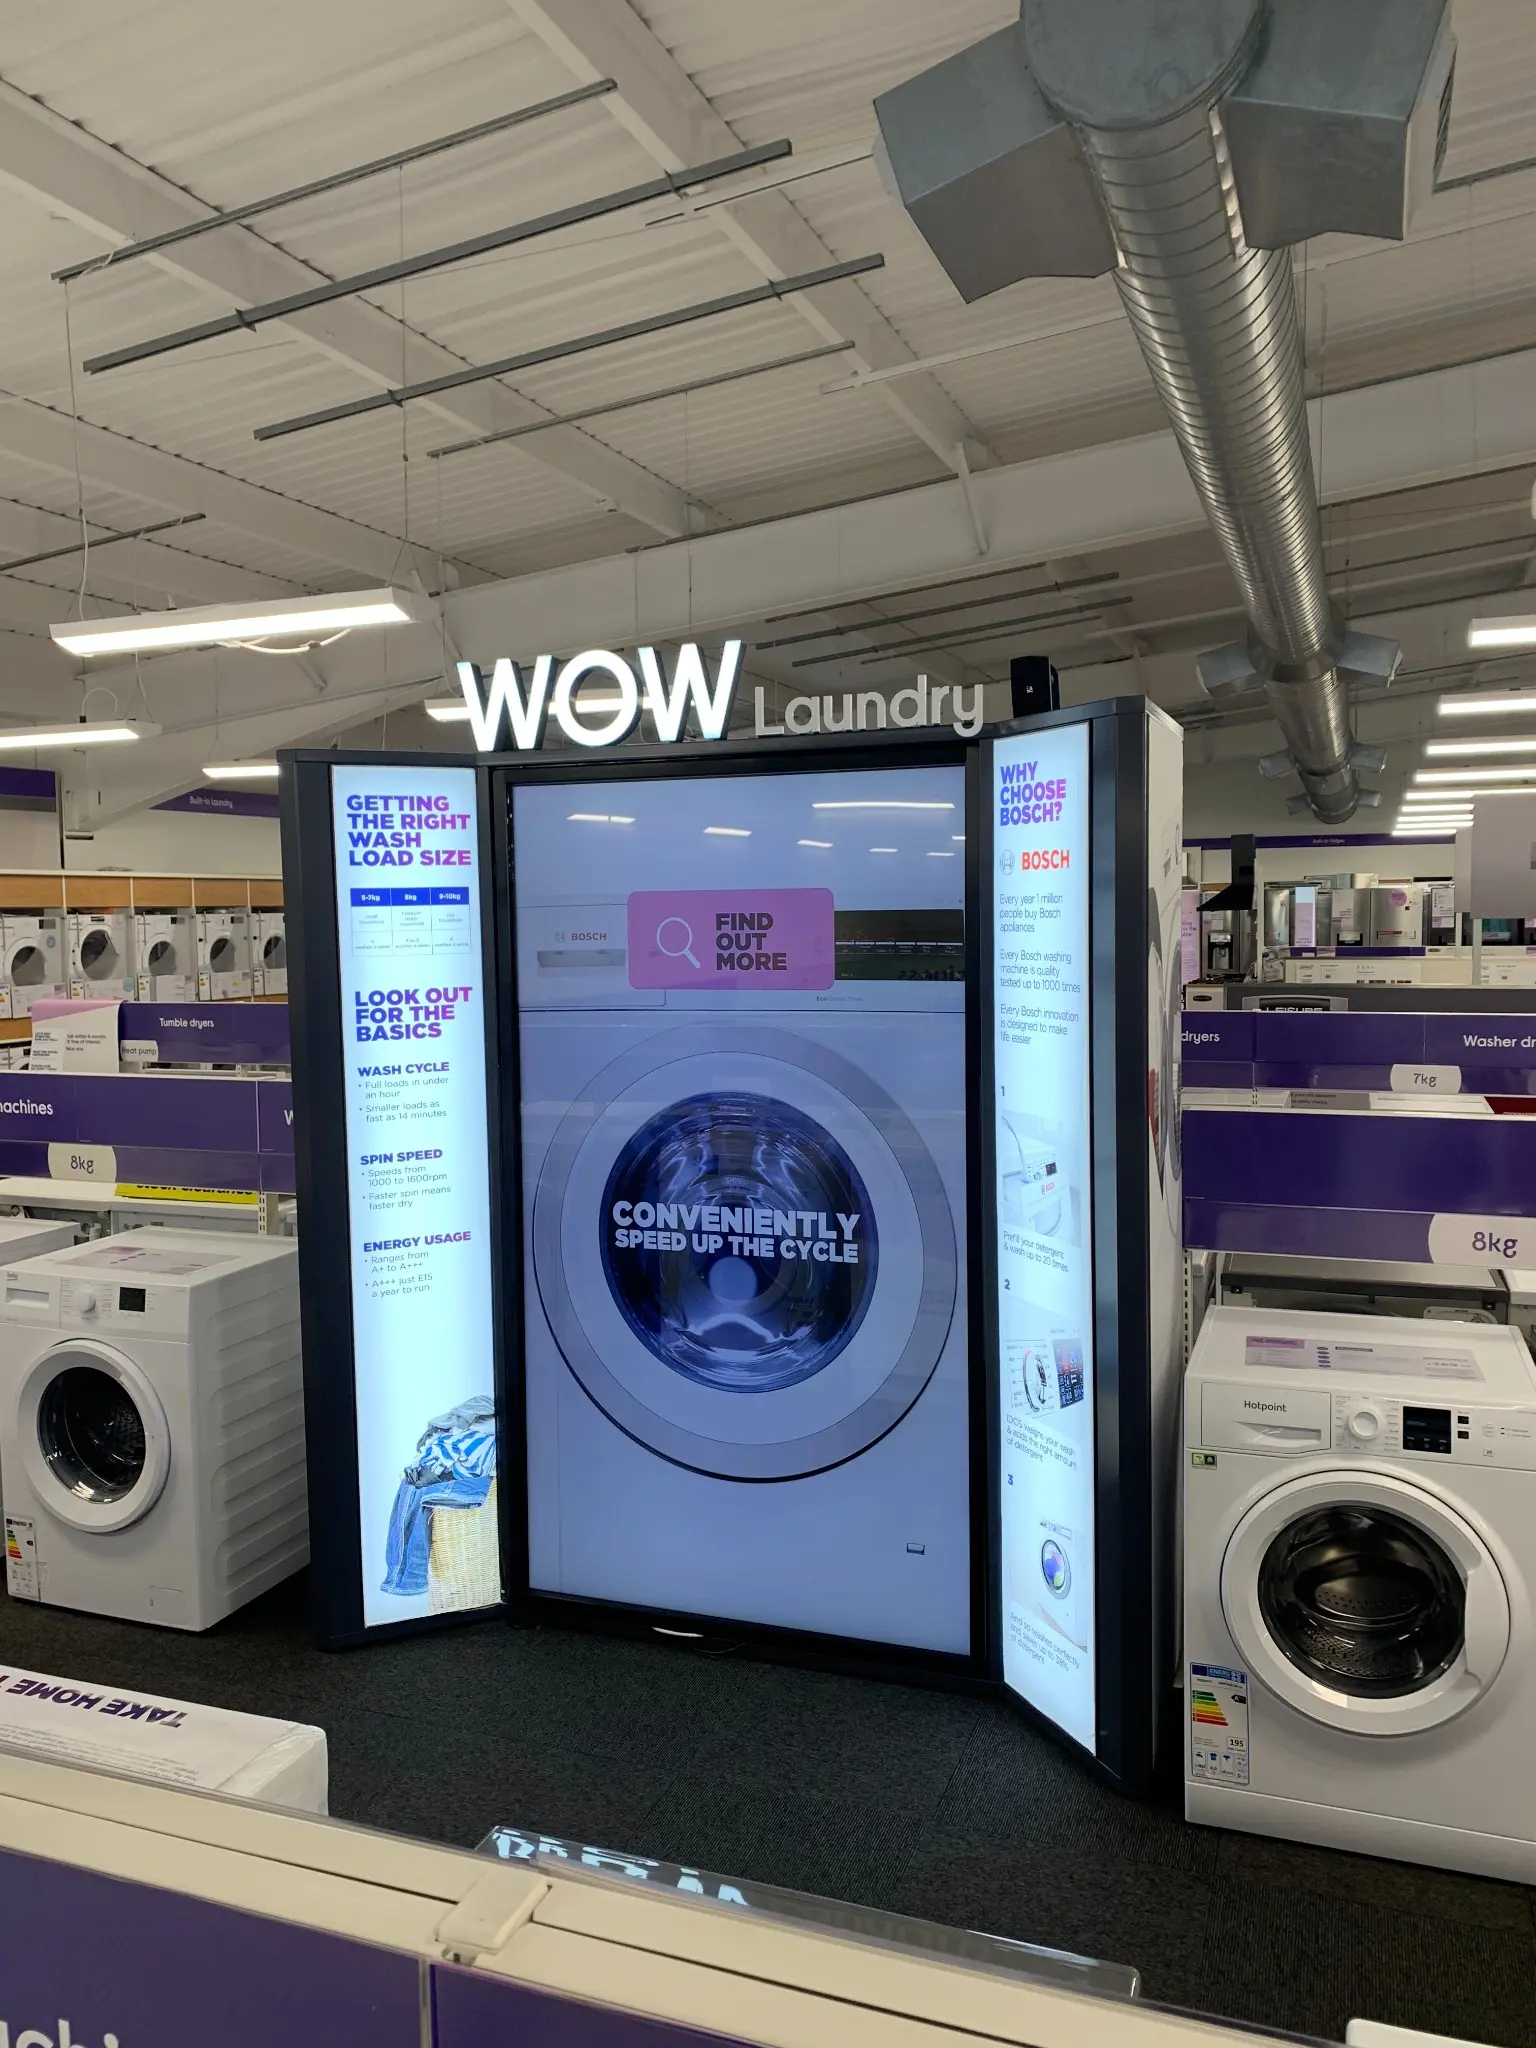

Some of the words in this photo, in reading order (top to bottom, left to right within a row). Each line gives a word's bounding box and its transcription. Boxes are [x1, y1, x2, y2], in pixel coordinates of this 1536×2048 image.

[457, 640, 746, 751] WOW
[754, 674, 984, 738] Laundry
[1000, 761, 1038, 785] WHY
[1000, 778, 1066, 805] CHOOSE
[347, 795, 449, 811] GETTING
[1000, 801, 1062, 826] BOSCH?
[347, 814, 395, 830] THE
[401, 814, 471, 830] RIGHT
[349, 832, 422, 848] WASH
[349, 850, 414, 866] LOAD
[420, 850, 472, 865] SIZE
[1021, 849, 1070, 871] BOSCH
[1000, 893, 1018, 906] Every
[1020, 896, 1035, 906] year
[1040, 893, 1063, 904] million
[715, 912, 774, 931] FIND
[1000, 908, 1022, 920] people
[1024, 908, 1038, 920] buy
[1040, 908, 1060, 918] Bosch
[1000, 922, 1035, 933] appliances
[571, 932, 607, 941] BOSCH
[715, 933, 767, 951] OUT
[715, 952, 787, 971] MORE
[1000, 948, 1018, 962] Every
[1020, 950, 1042, 960] Bosch
[1044, 951, 1072, 964] washing
[1000, 964, 1028, 974] machine
[1030, 964, 1036, 974] is
[1037, 965, 1060, 978] quality
[1000, 977, 1020, 988] tested
[1022, 980, 1032, 990] up
[1034, 979, 1040, 990] to
[1042, 980, 1060, 990] 1000
[1062, 982, 1080, 992] times
[355, 989, 420, 1006] LOOK
[425, 987, 473, 1004] OUT
[356, 1006, 403, 1024] FOR
[409, 1005, 455, 1022] THE
[1000, 1004, 1020, 1017] Every
[1020, 1006, 1042, 1018] Bosch
[1044, 1008, 1079, 1022] innovation
[159, 1017, 188, 1028] Tumble
[189, 1018, 215, 1030] dryers
[1000, 1017, 1006, 1028] is
[1007, 1018, 1038, 1032] designed
[1040, 1022, 1046, 1032] to
[1048, 1024, 1068, 1036] make
[356, 1022, 442, 1042] BASICS
[1000, 1030, 1010, 1042] life
[1012, 1033, 1032, 1044] easier
[1181, 1030, 1220, 1044] dryers
[1463, 1034, 1517, 1048] Washer
[122, 1046, 137, 1054] Heat
[138, 1048, 157, 1056] pump
[357, 1065, 402, 1077] WASH
[405, 1062, 450, 1074] CYCLE
[365, 1081, 382, 1089] Full
[384, 1080, 409, 1088] loads
[422, 1077, 449, 1085] under
[1413, 1074, 1437, 1088] 7kg
[380, 1090, 400, 1098] hour
[1000, 1086, 1005, 1096] 1
[366, 1104, 400, 1112] Smaller
[402, 1102, 428, 1110] loads
[366, 1114, 384, 1122] fast
[410, 1110, 447, 1120] minutes
[70, 1155, 94, 1174] 8kg
[360, 1153, 394, 1166] SPIN
[396, 1149, 443, 1162] SPEED
[368, 1167, 402, 1178] Speeds
[368, 1179, 392, 1187] 1000
[407, 1173, 448, 1184] 1600rpm
[369, 1192, 397, 1200] Faster
[400, 1189, 419, 1198] spin
[422, 1186, 451, 1195] means
[370, 1202, 395, 1210] faster
[398, 1200, 413, 1208] dry
[612, 1200, 860, 1241] CONVENIENTLY
[364, 1236, 420, 1252] ENERGY
[424, 1230, 472, 1245] USAGE
[614, 1229, 687, 1252] SPEED
[692, 1234, 723, 1254] UP
[728, 1236, 775, 1257] THE
[779, 1239, 859, 1264] CYCLE
[1021, 1238, 1034, 1248] your
[1036, 1242, 1064, 1259] detergent
[1472, 1231, 1518, 1258] 8kg
[371, 1255, 404, 1265] Ranges
[1010, 1246, 1025, 1256] wash
[1026, 1250, 1034, 1260] up
[1036, 1252, 1042, 1262] to
[1042, 1254, 1050, 1266] 20
[1052, 1260, 1068, 1272] times
[372, 1266, 384, 1274] A+
[400, 1262, 422, 1270] A+++
[372, 1279, 396, 1288] A+++
[398, 1276, 416, 1286] just
[418, 1273, 433, 1282] £15
[1004, 1278, 1010, 1290] 2
[380, 1288, 400, 1298] year
[1244, 1400, 1287, 1412] Hotpoint
[1008, 1474, 1014, 1486] 3
[5, 1678, 106, 1710] HOME
[98, 1698, 188, 1729] TAKE
[1230, 1739, 1244, 1748] 195
